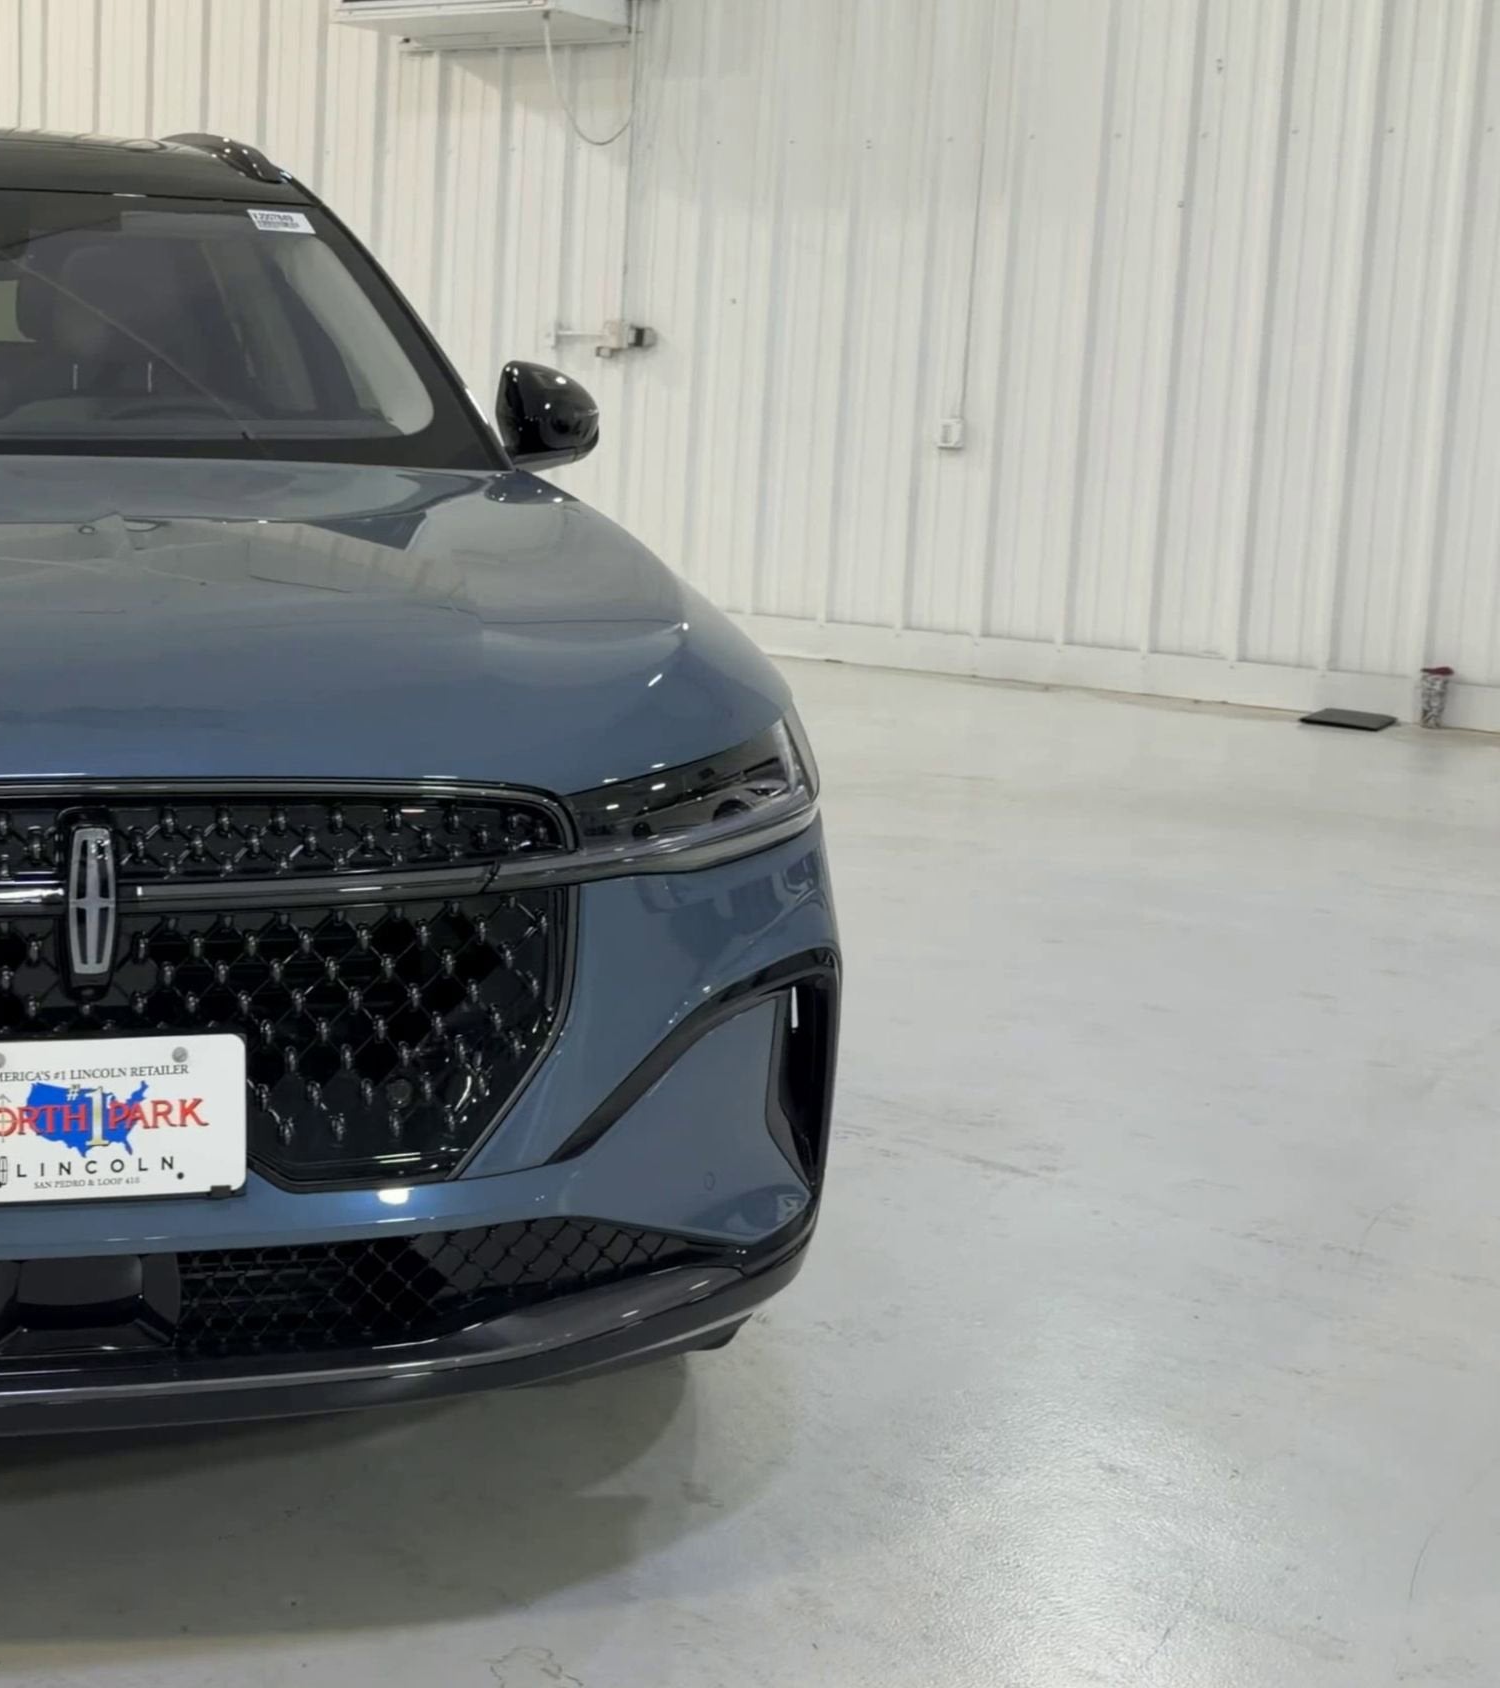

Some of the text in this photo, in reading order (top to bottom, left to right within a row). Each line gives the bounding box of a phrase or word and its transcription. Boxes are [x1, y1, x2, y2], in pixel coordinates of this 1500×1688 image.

[53, 1070, 66, 1081] #1
[70, 1067, 127, 1080] LINCOLN
[130, 1064, 189, 1077] RETAILER
[108, 1098, 210, 1130] PARK
[16, 1156, 174, 1178] LINCOLN
[34, 1181, 52, 1190] SAN
[54, 1179, 85, 1189] PEDRO
[98, 1177, 123, 1187] LOOP
